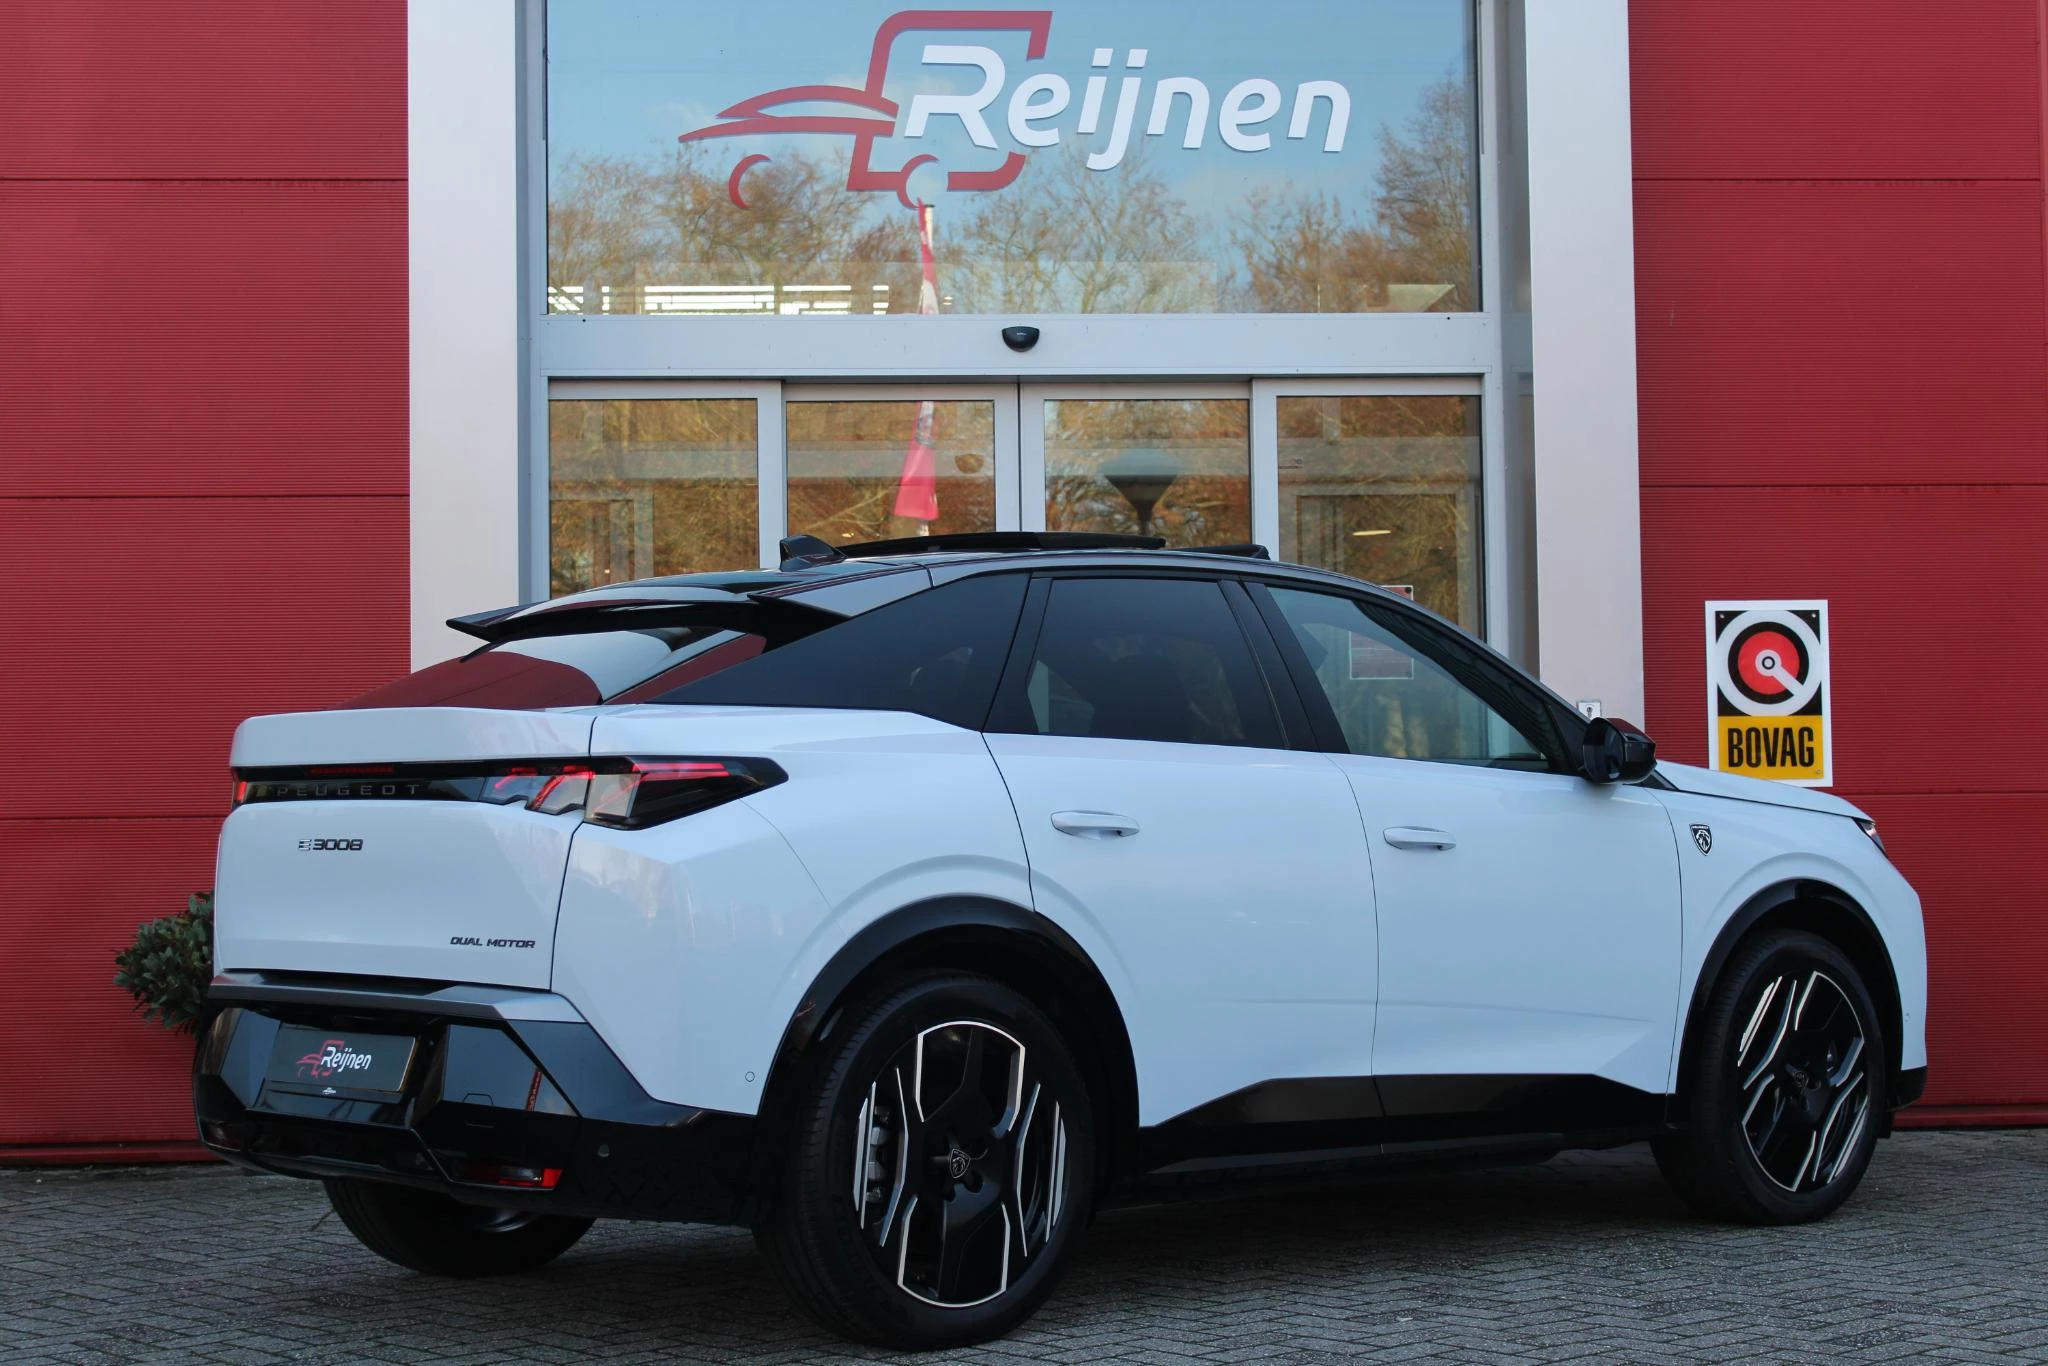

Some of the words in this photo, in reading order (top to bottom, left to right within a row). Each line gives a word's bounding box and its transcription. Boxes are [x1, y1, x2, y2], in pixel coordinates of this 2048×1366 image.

[903, 45, 1352, 170] Reijnen
[1727, 726, 1815, 768] BOVAG
[276, 784, 421, 797] PEUGEOT
[450, 936, 483, 947] DUAL
[486, 938, 536, 949] MOTOR
[320, 1046, 372, 1072] Reijnen
